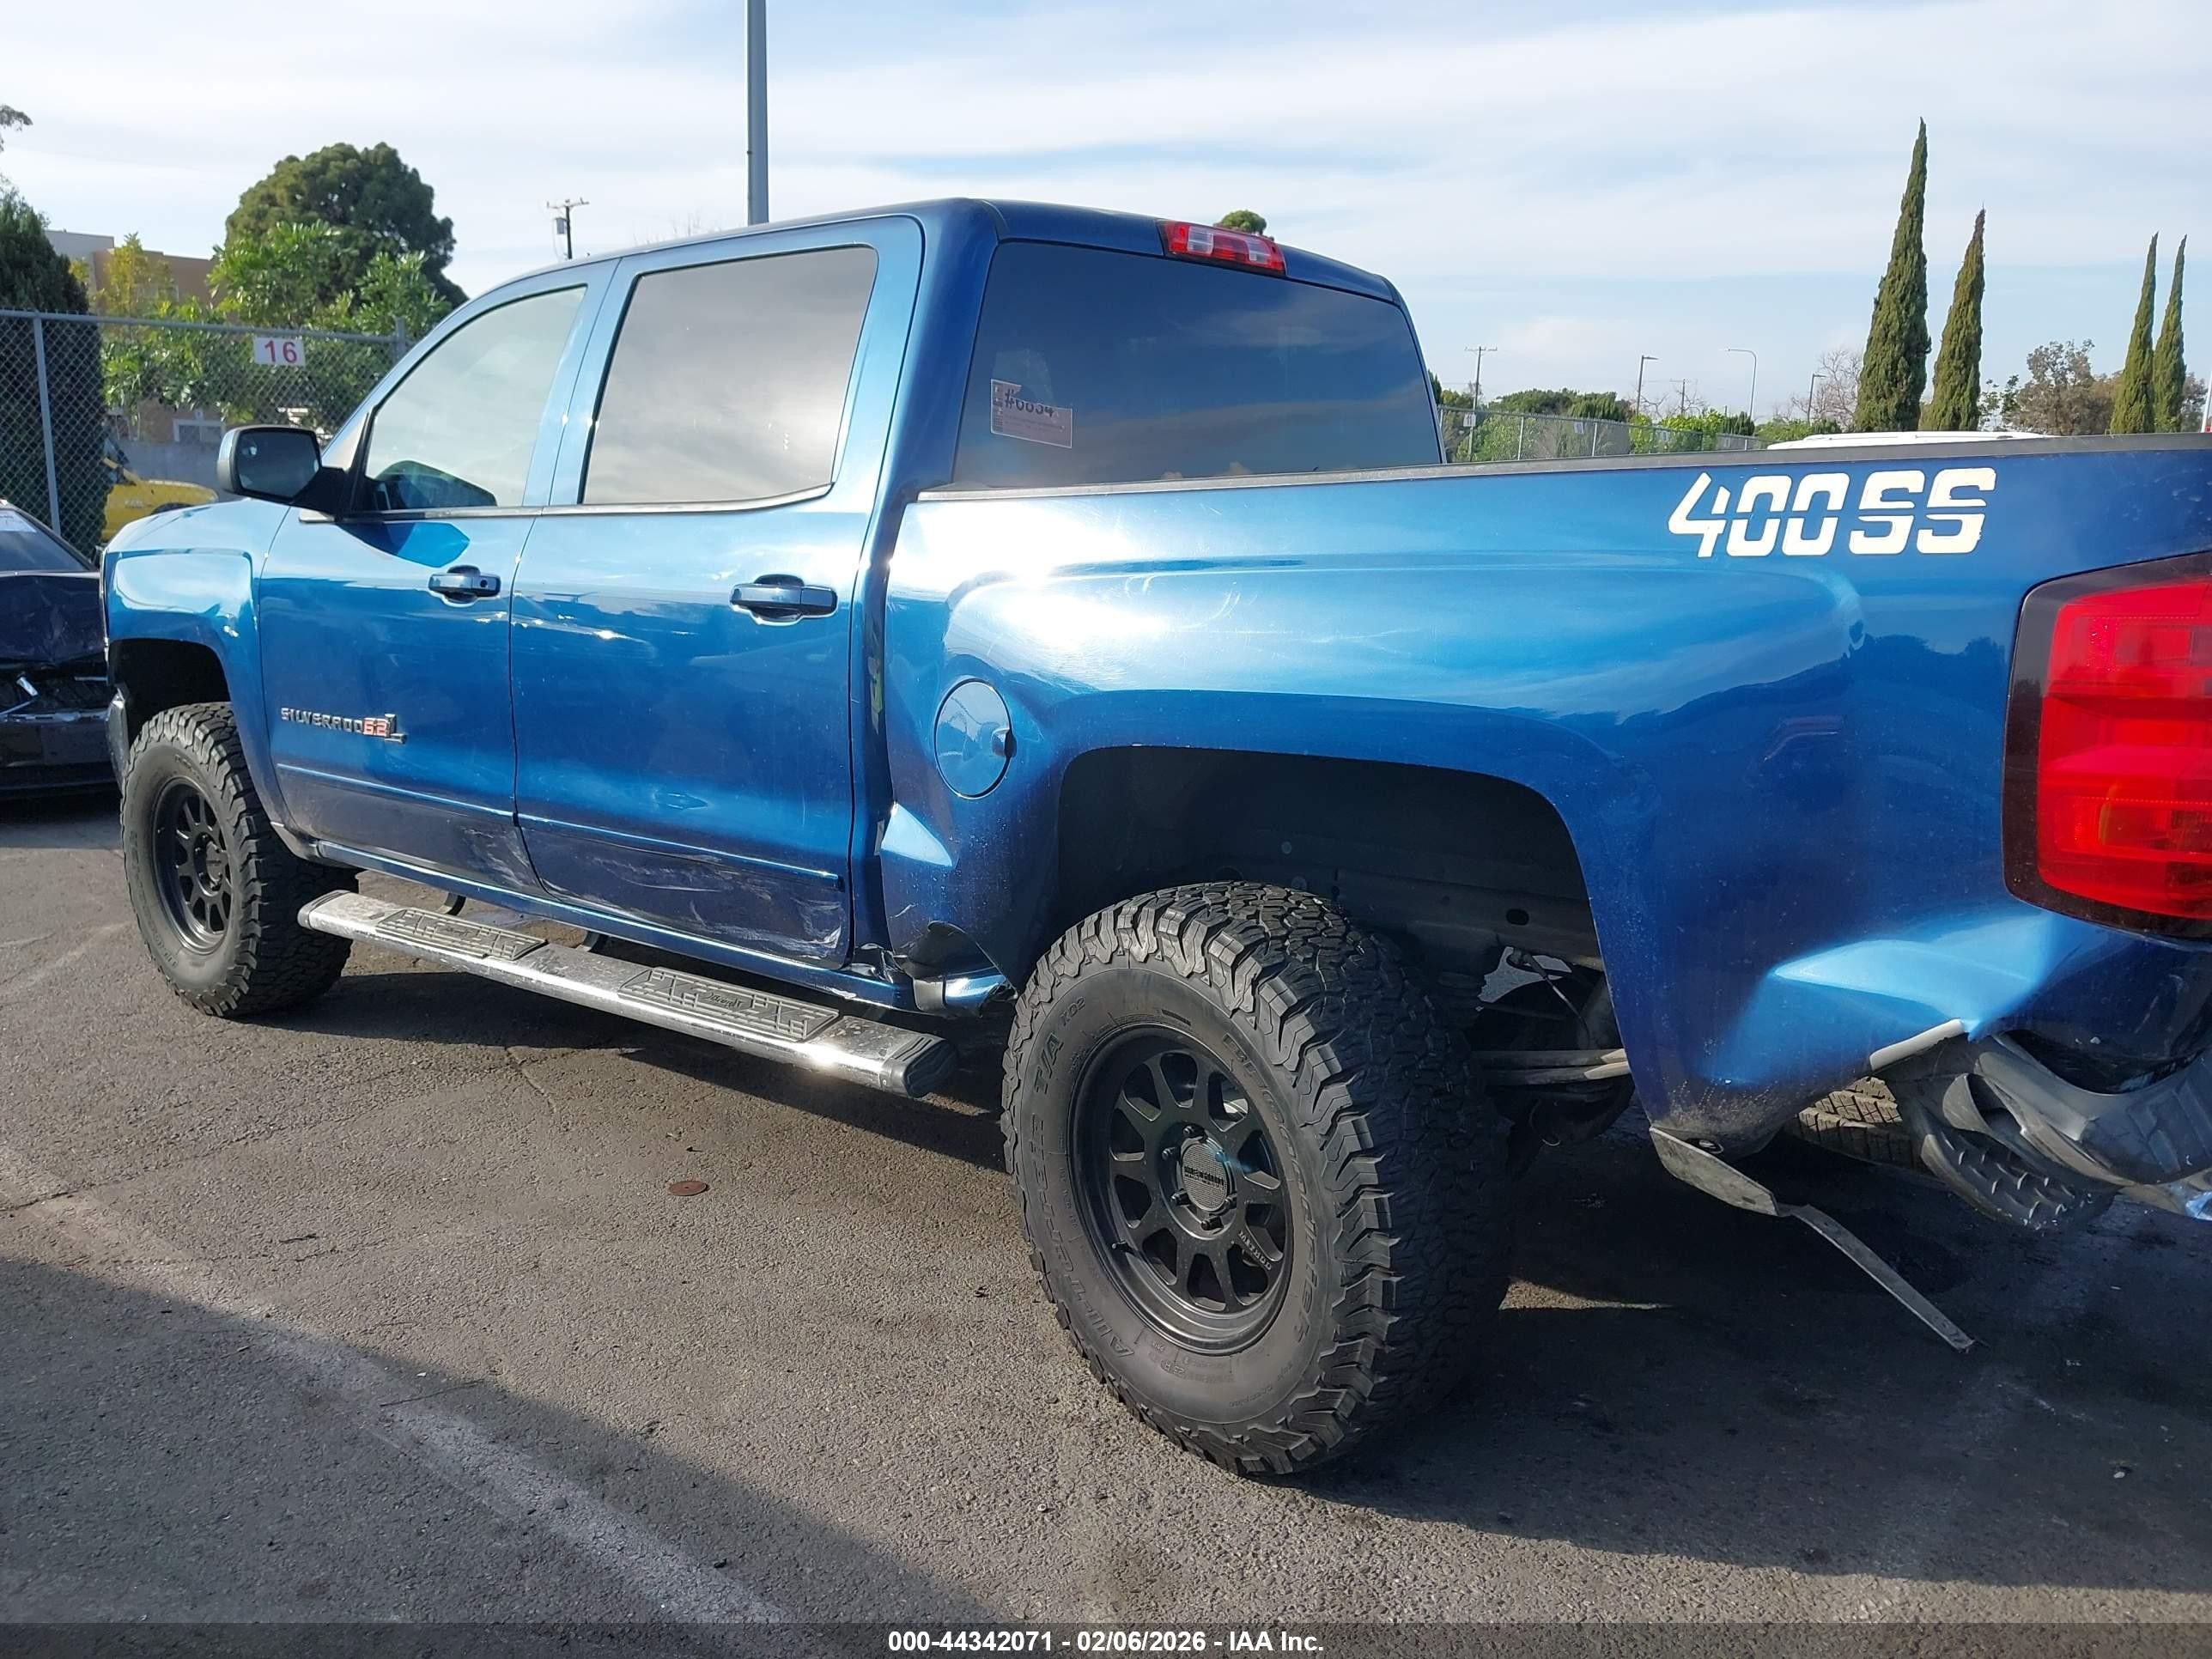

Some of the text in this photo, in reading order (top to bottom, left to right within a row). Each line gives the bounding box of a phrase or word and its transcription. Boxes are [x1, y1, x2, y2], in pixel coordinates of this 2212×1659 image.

[264, 340, 297, 363] 16
[281, 708, 363, 734] SILVERADO
[1033, 1030, 1065, 1096] T/A
